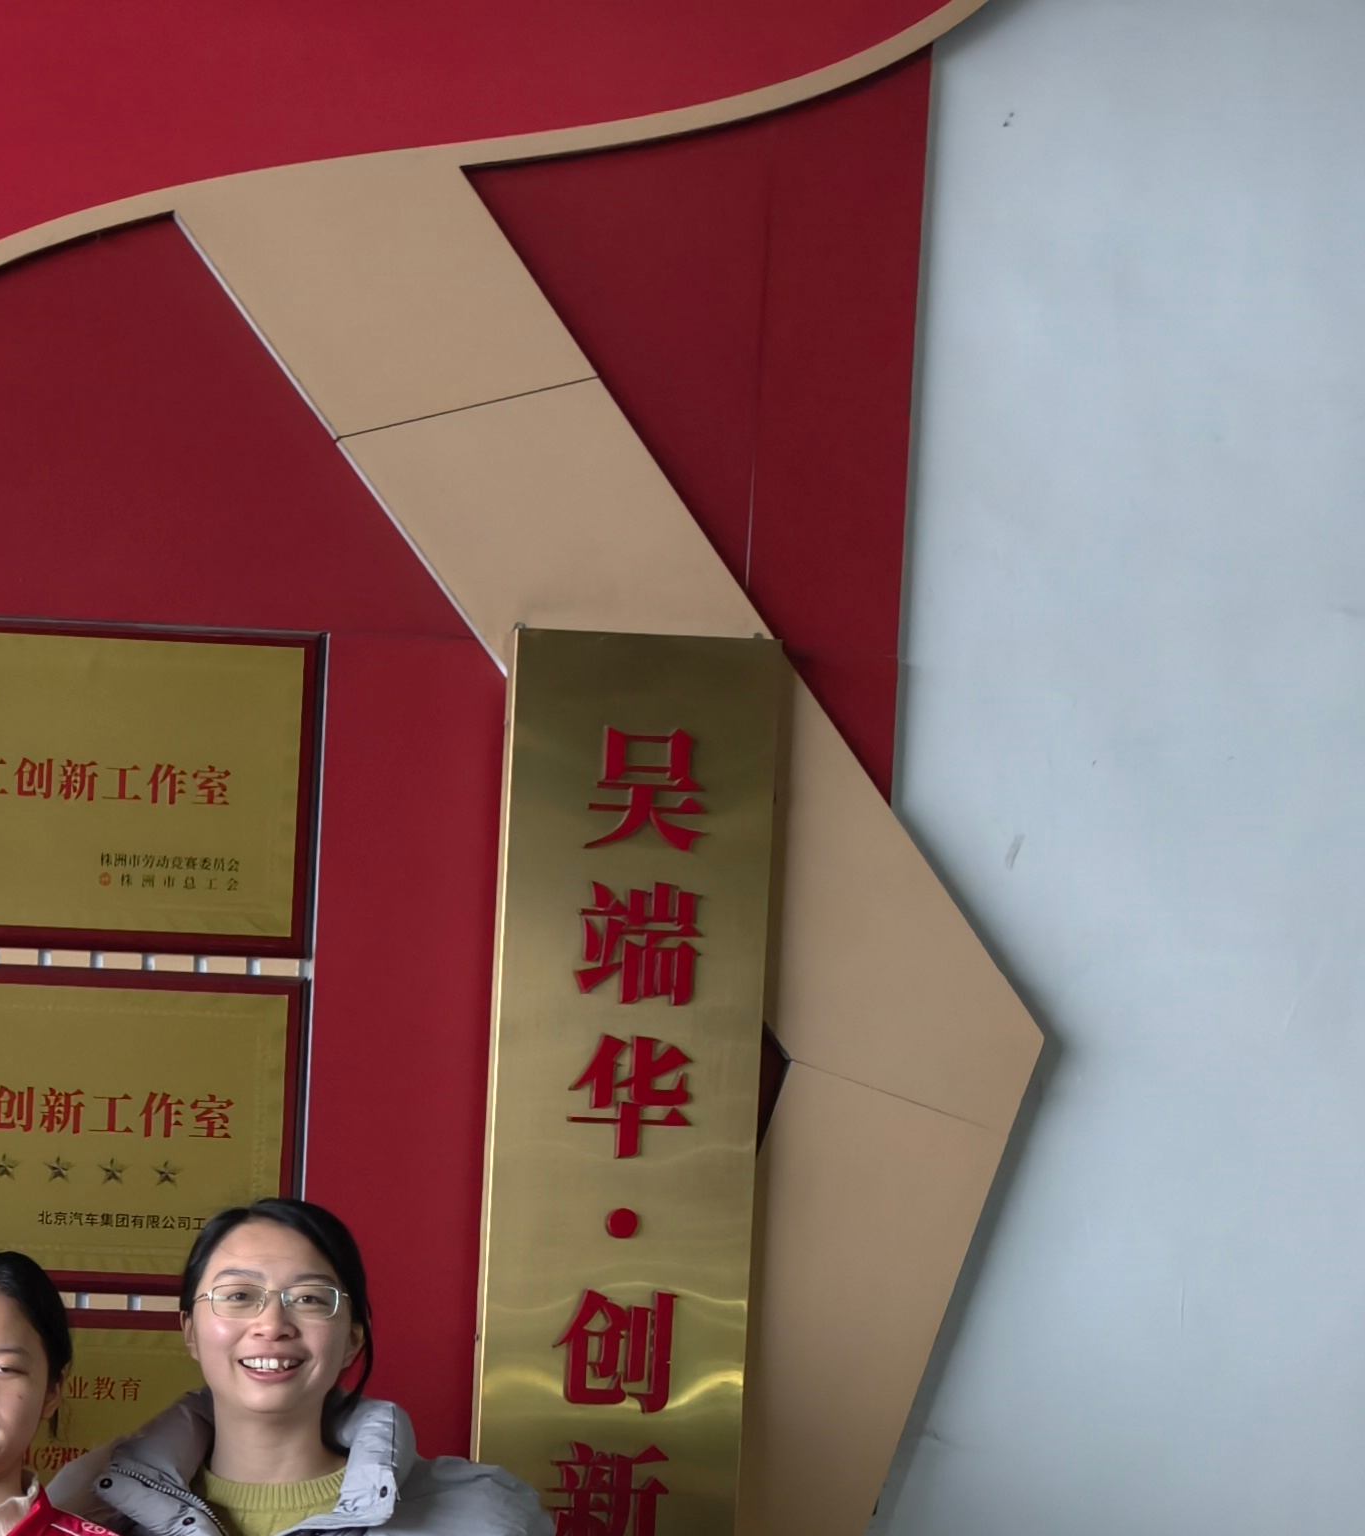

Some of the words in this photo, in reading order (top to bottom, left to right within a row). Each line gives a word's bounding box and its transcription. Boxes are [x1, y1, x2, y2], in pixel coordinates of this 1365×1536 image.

[38, 1210, 207, 1231] 北京汽车集团有限公司工
[67, 1376, 142, 1401] 业教育
